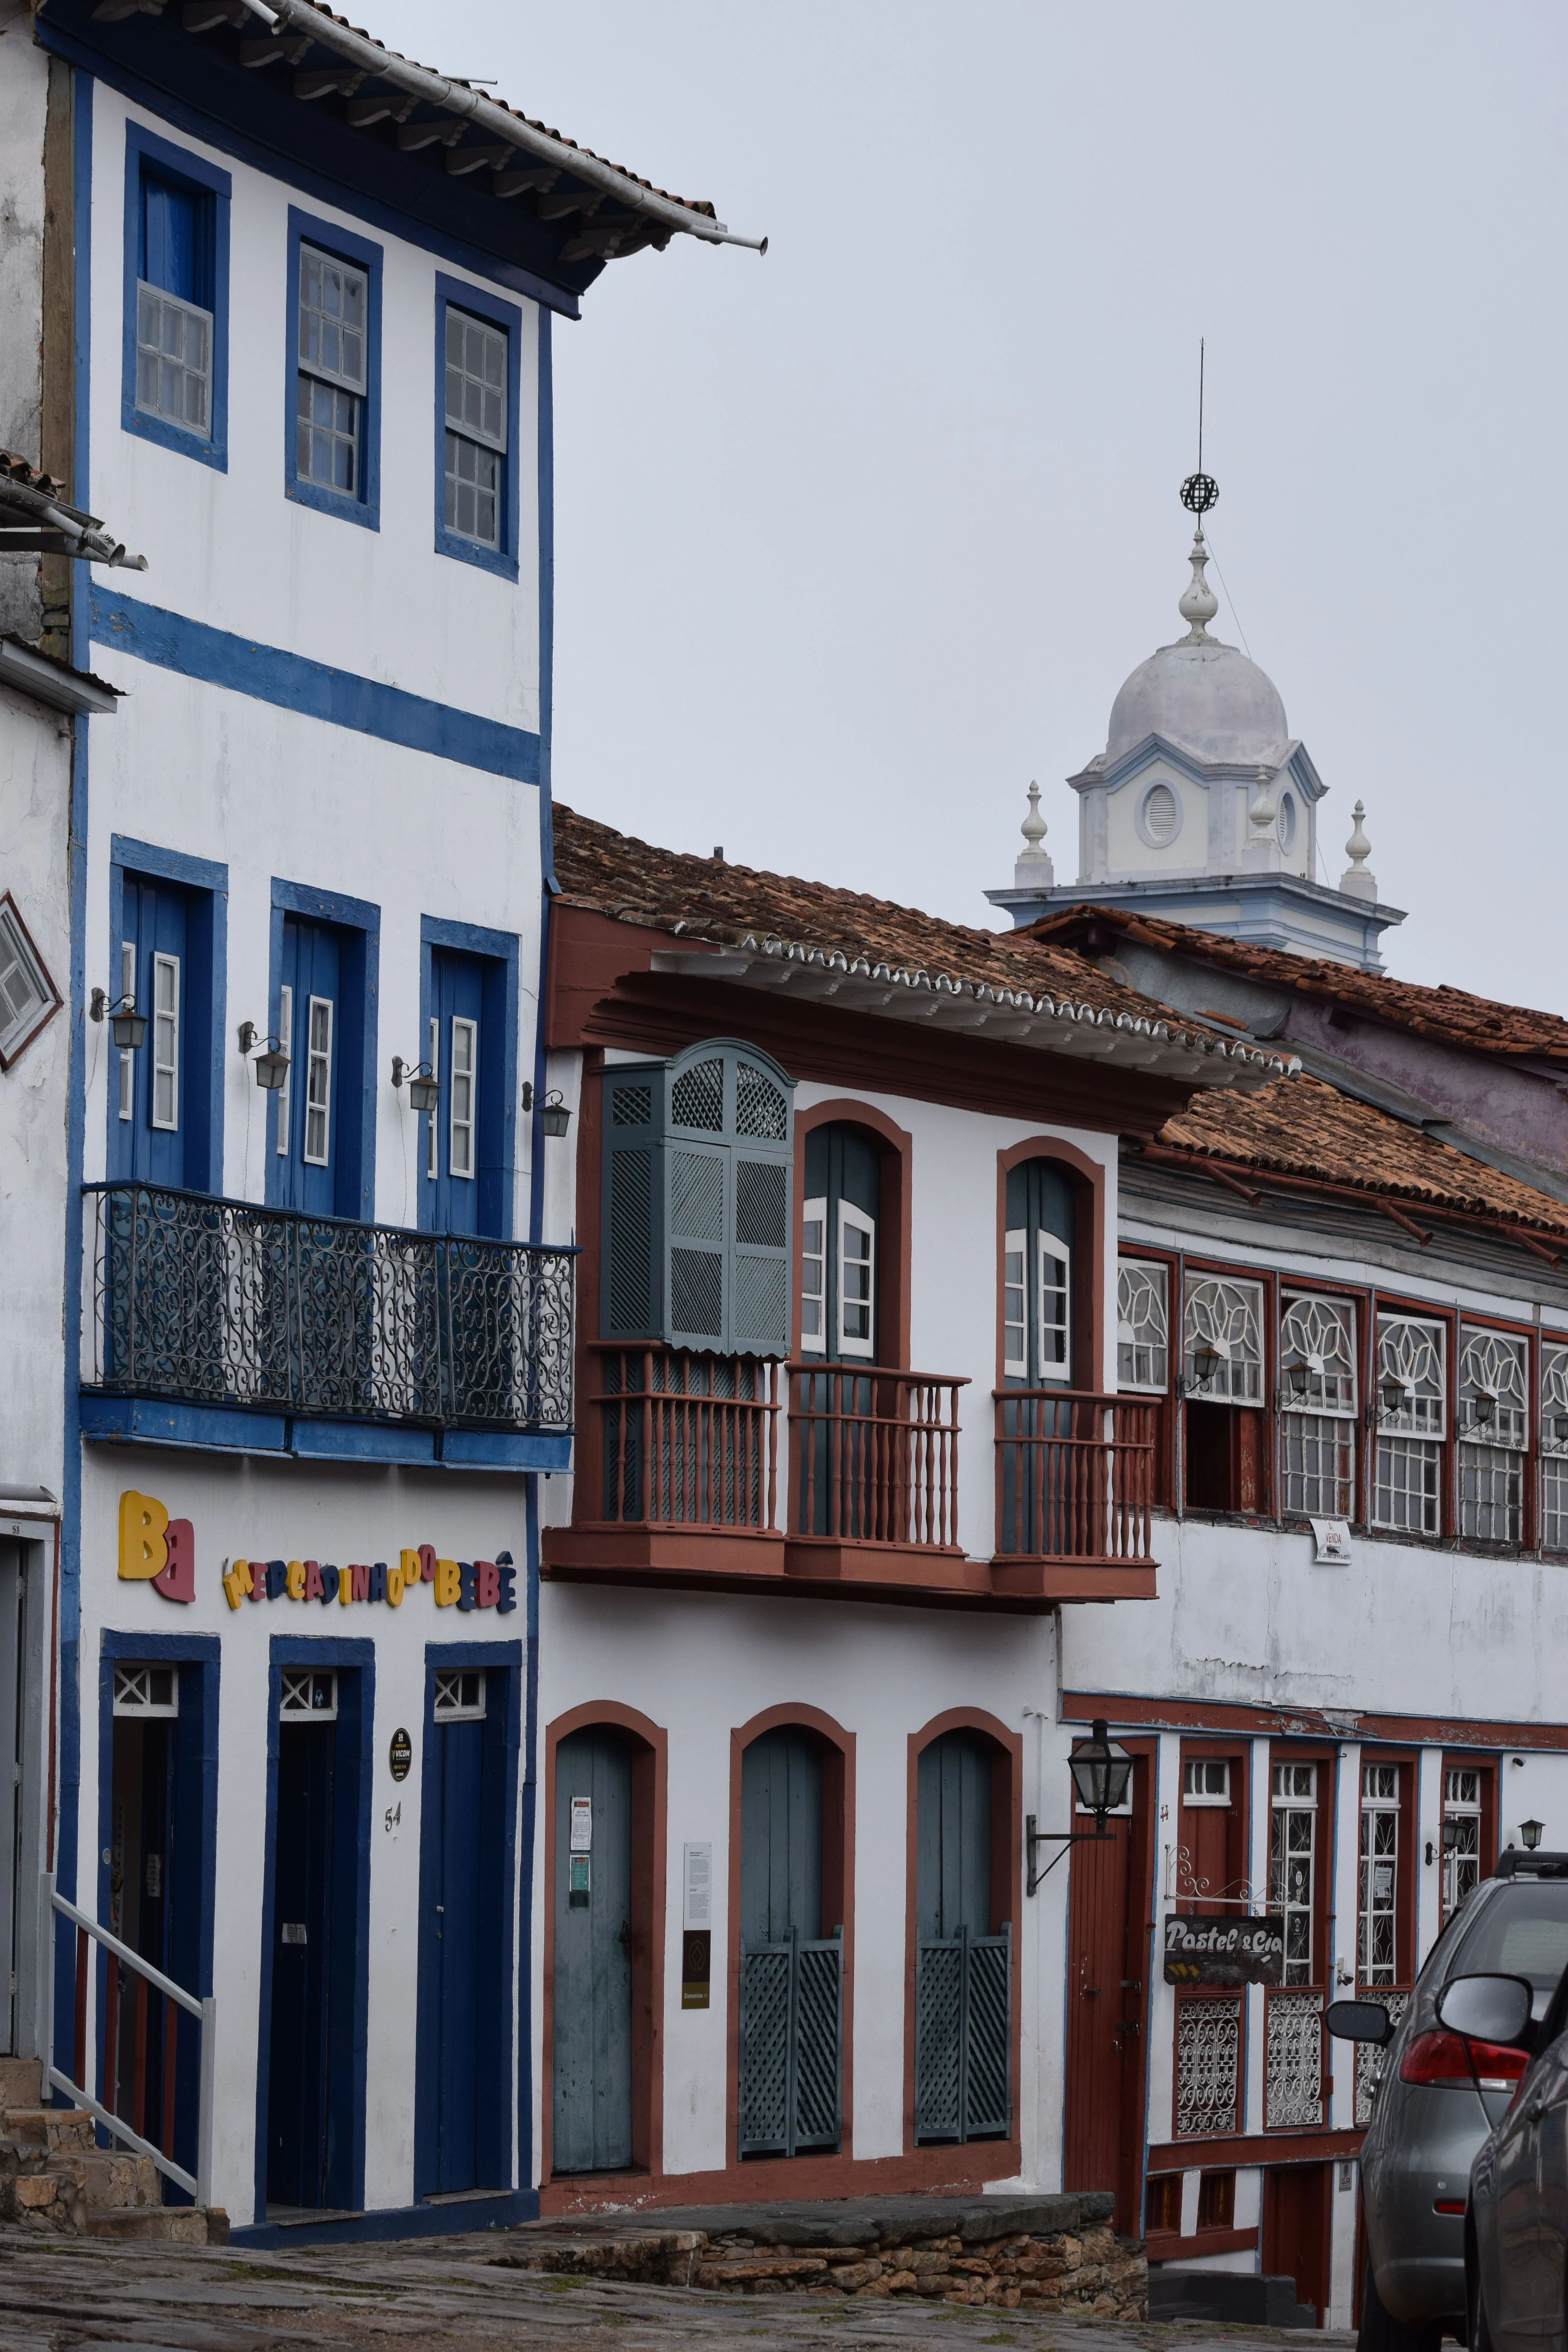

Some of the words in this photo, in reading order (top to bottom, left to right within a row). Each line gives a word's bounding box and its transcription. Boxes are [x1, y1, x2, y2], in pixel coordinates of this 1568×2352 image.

[1325, 1532, 1341, 1544] VENDA
[1328, 1521, 1334, 1531] A
[223, 1559, 403, 1610] MERCADINHO
[401, 1544, 436, 1585] DO
[434, 1551, 517, 1613] BEBÊ
[385, 1800, 401, 1833] 54
[1160, 1805, 1169, 1822] 44
[1167, 1920, 1238, 1951] Pastel
[1243, 1936, 1251, 1950] &
[1252, 1930, 1282, 1954] Cia
